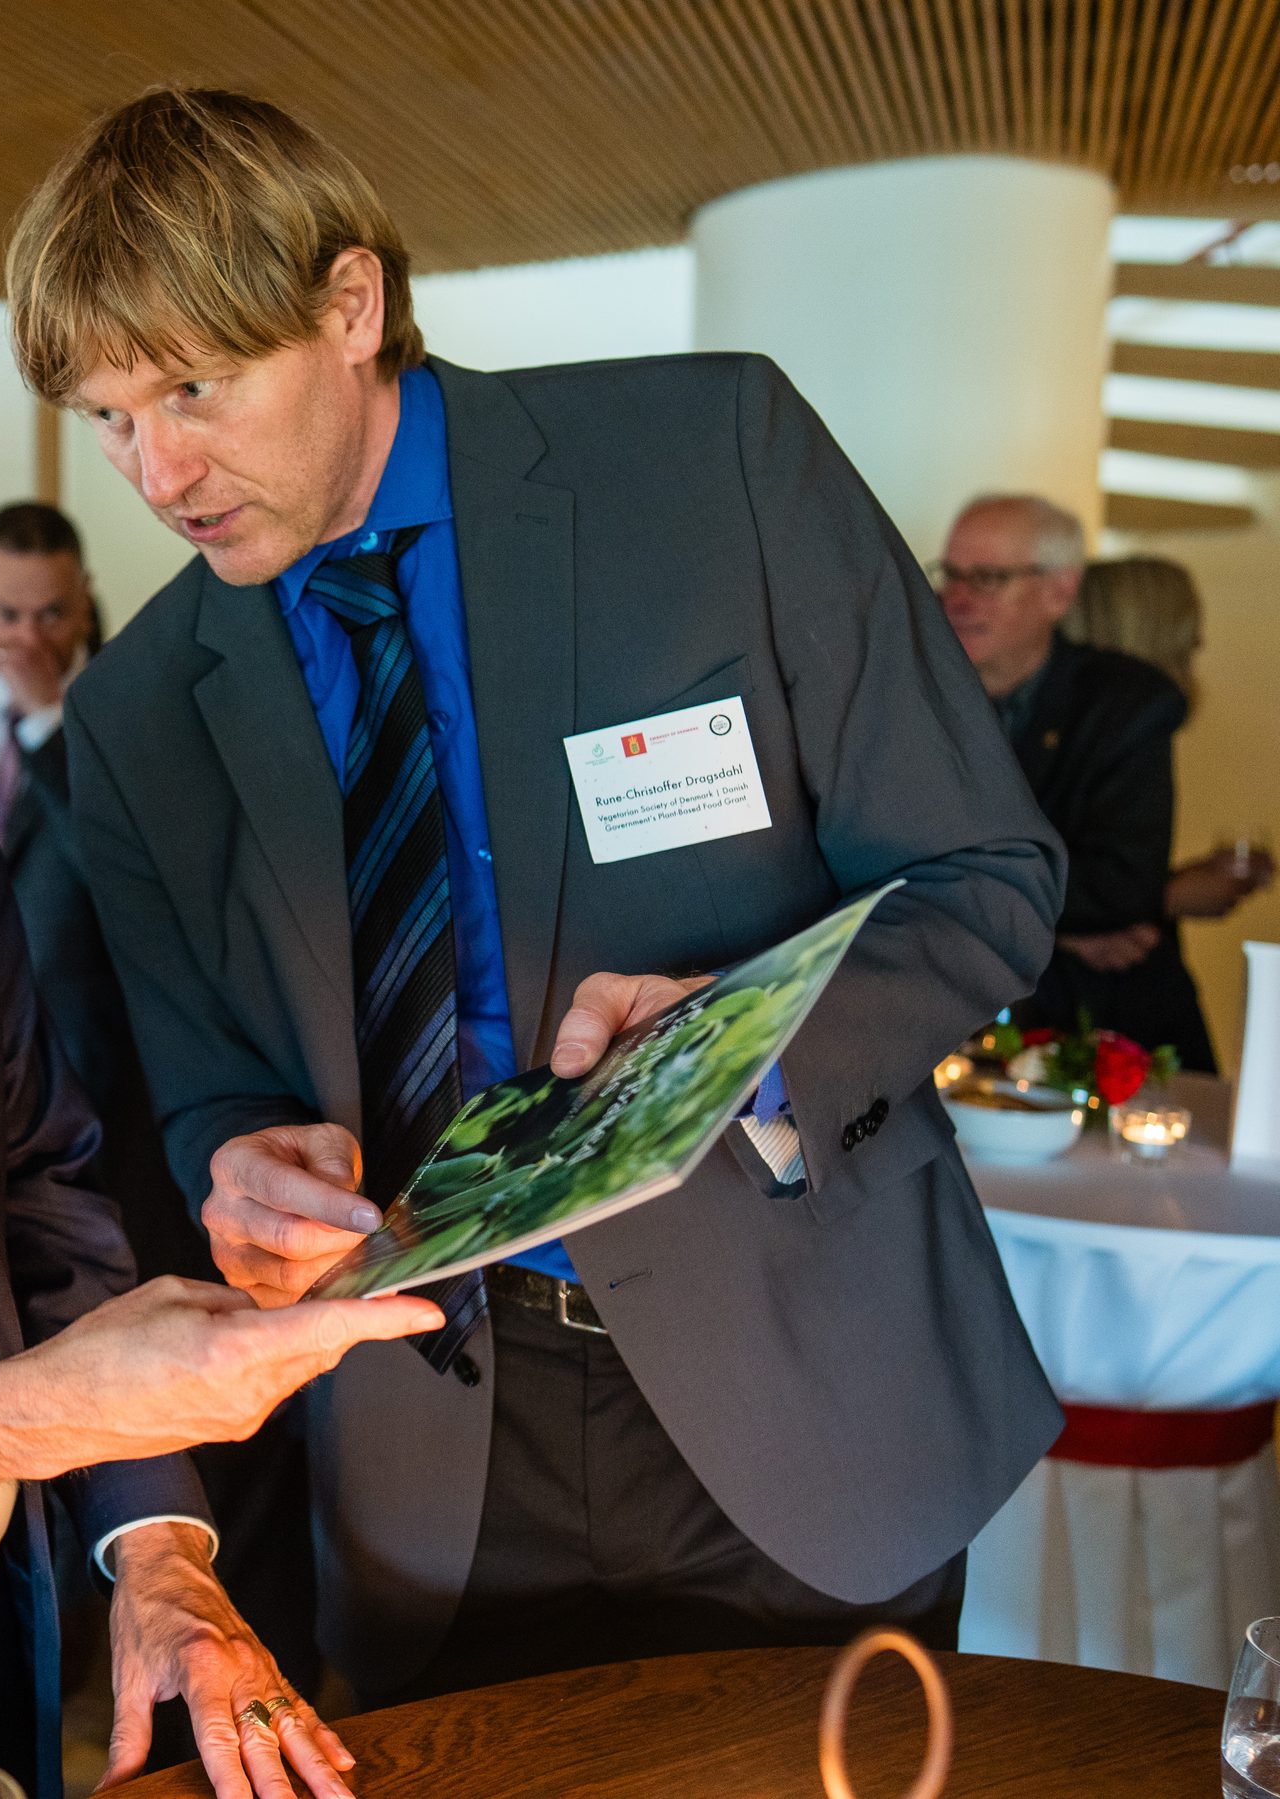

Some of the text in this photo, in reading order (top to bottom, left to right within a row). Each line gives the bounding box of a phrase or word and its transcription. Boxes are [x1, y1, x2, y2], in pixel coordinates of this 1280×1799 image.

[595, 763, 743, 807] Rune-Christoffer Dragsdahl
[598, 809, 639, 822] Vegetarian
[640, 802, 668, 813] Society
[670, 797, 678, 806] of
[679, 790, 713, 804] Denmark
[722, 782, 749, 795] Danish
[605, 795, 747, 832] Government's Plant-Based Food Grant
